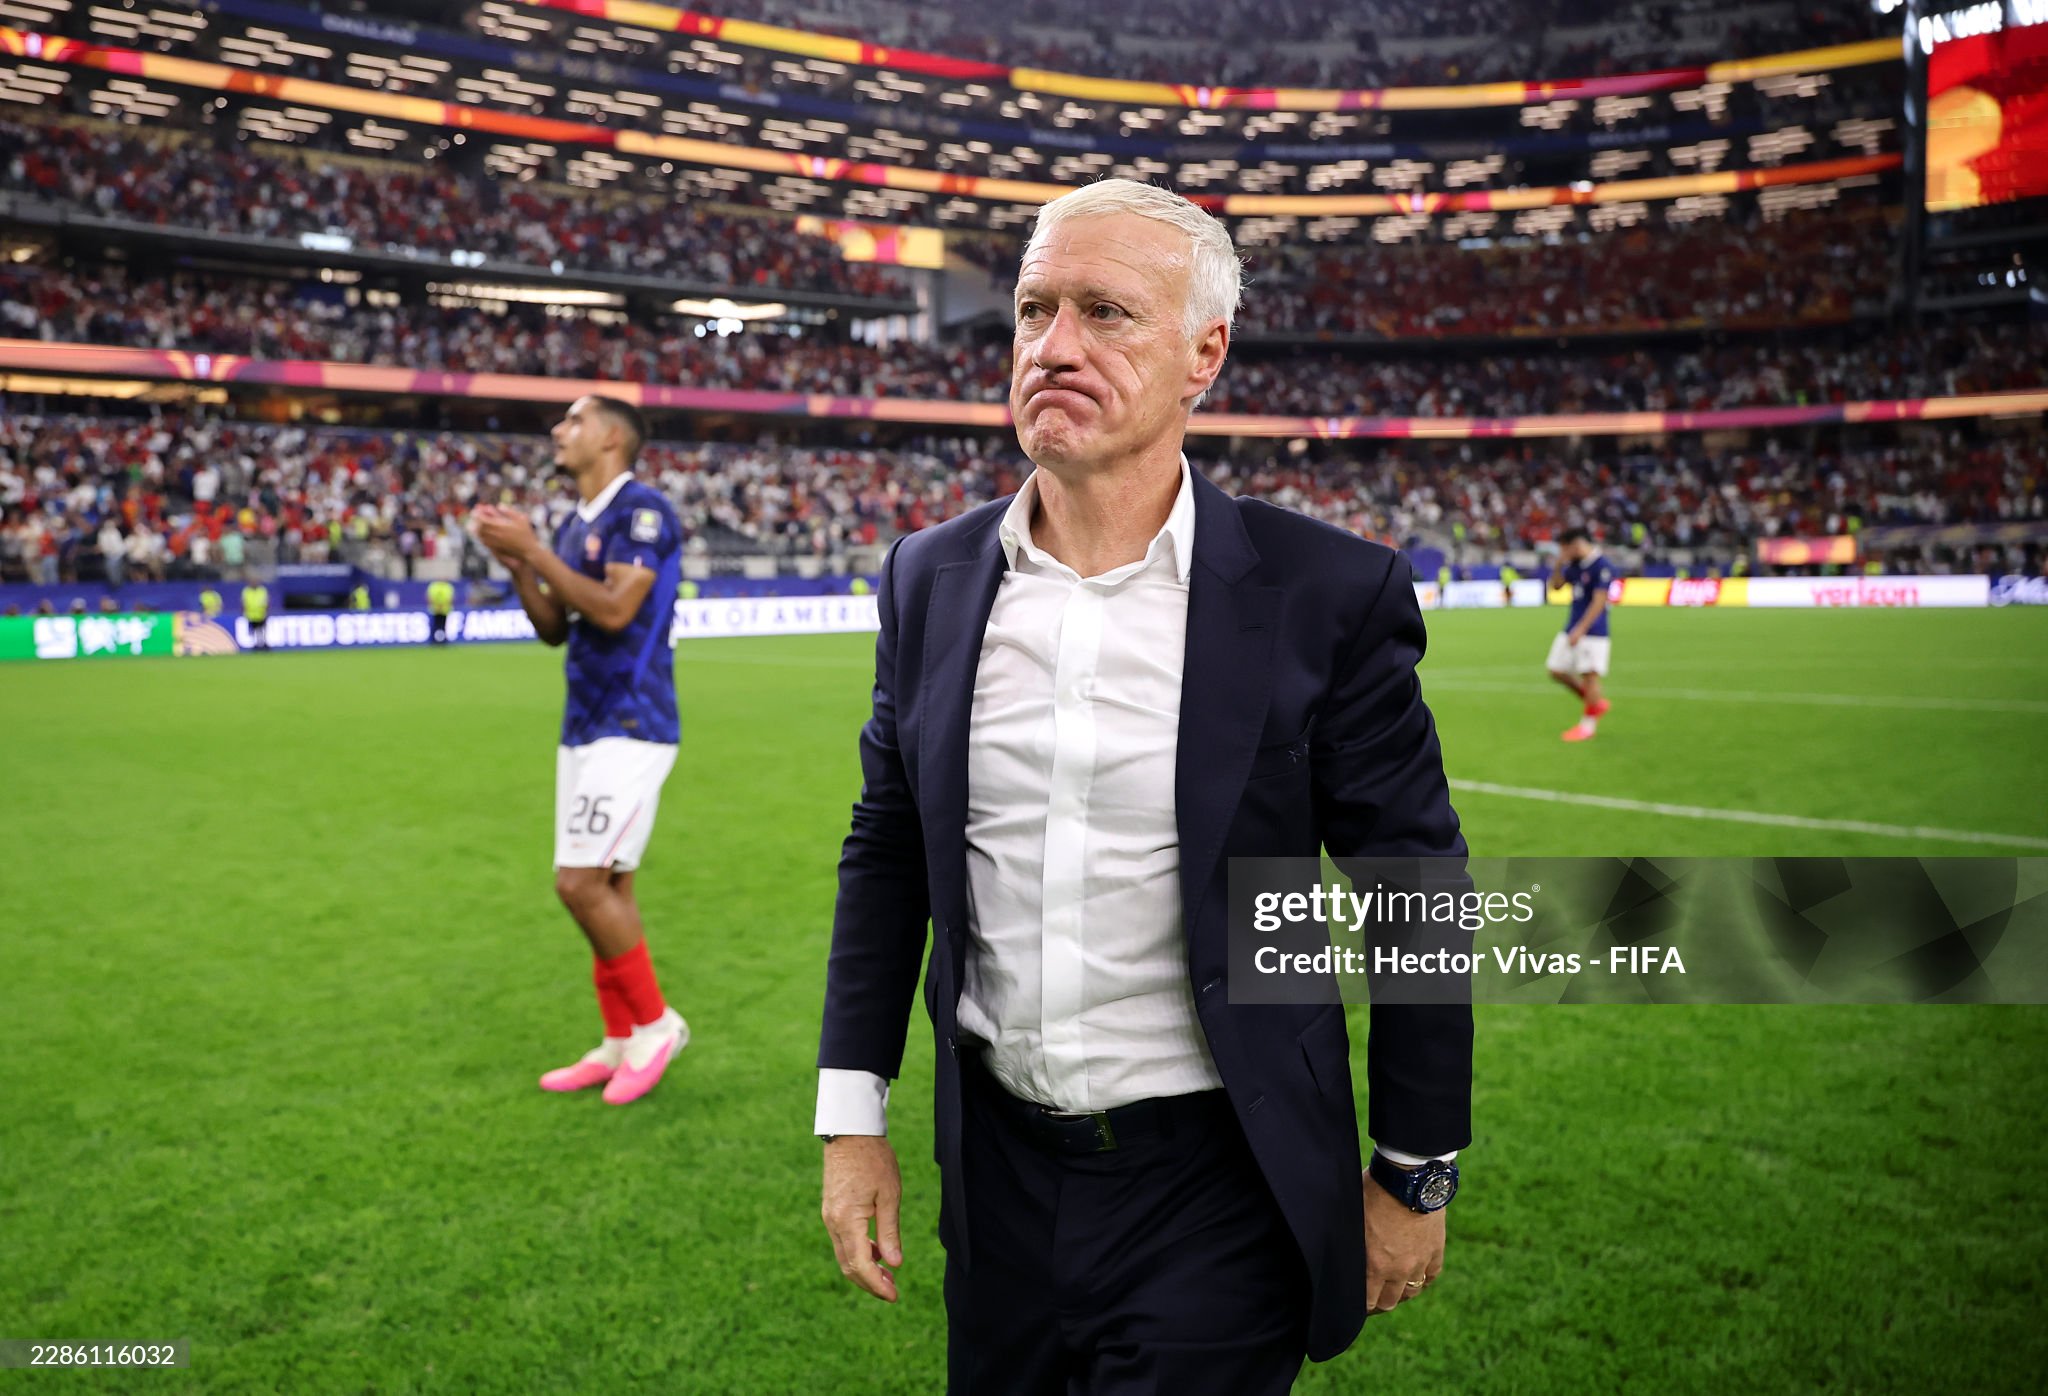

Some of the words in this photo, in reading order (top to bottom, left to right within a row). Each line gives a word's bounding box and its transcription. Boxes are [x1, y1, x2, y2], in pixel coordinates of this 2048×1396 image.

[1811, 576, 1919, 606] verizon
[335, 612, 430, 645] STATES
[773, 604, 880, 625] AMERIC
[567, 795, 613, 835] 26
